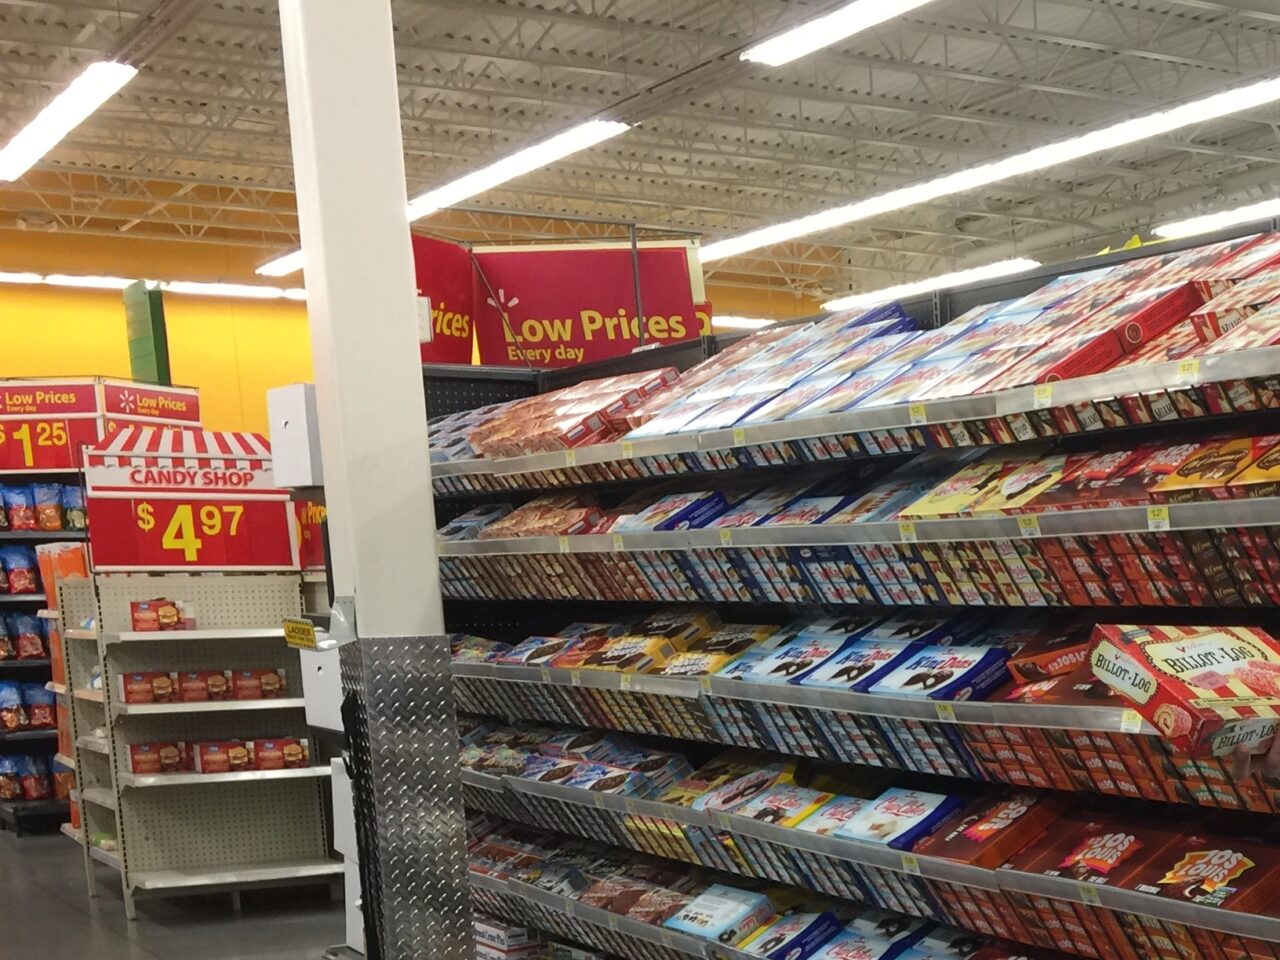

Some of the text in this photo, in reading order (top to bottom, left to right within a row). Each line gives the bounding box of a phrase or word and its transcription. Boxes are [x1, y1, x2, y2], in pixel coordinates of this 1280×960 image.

[431, 302, 469, 338] rices
[502, 308, 687, 343] Low Prices
[507, 345, 584, 362] Every day
[5, 391, 76, 405] Low Prices
[136, 394, 186, 411] Low Prices
[130, 469, 255, 487] CANDY SHOP
[1203, 850, 1244, 868] JOS
